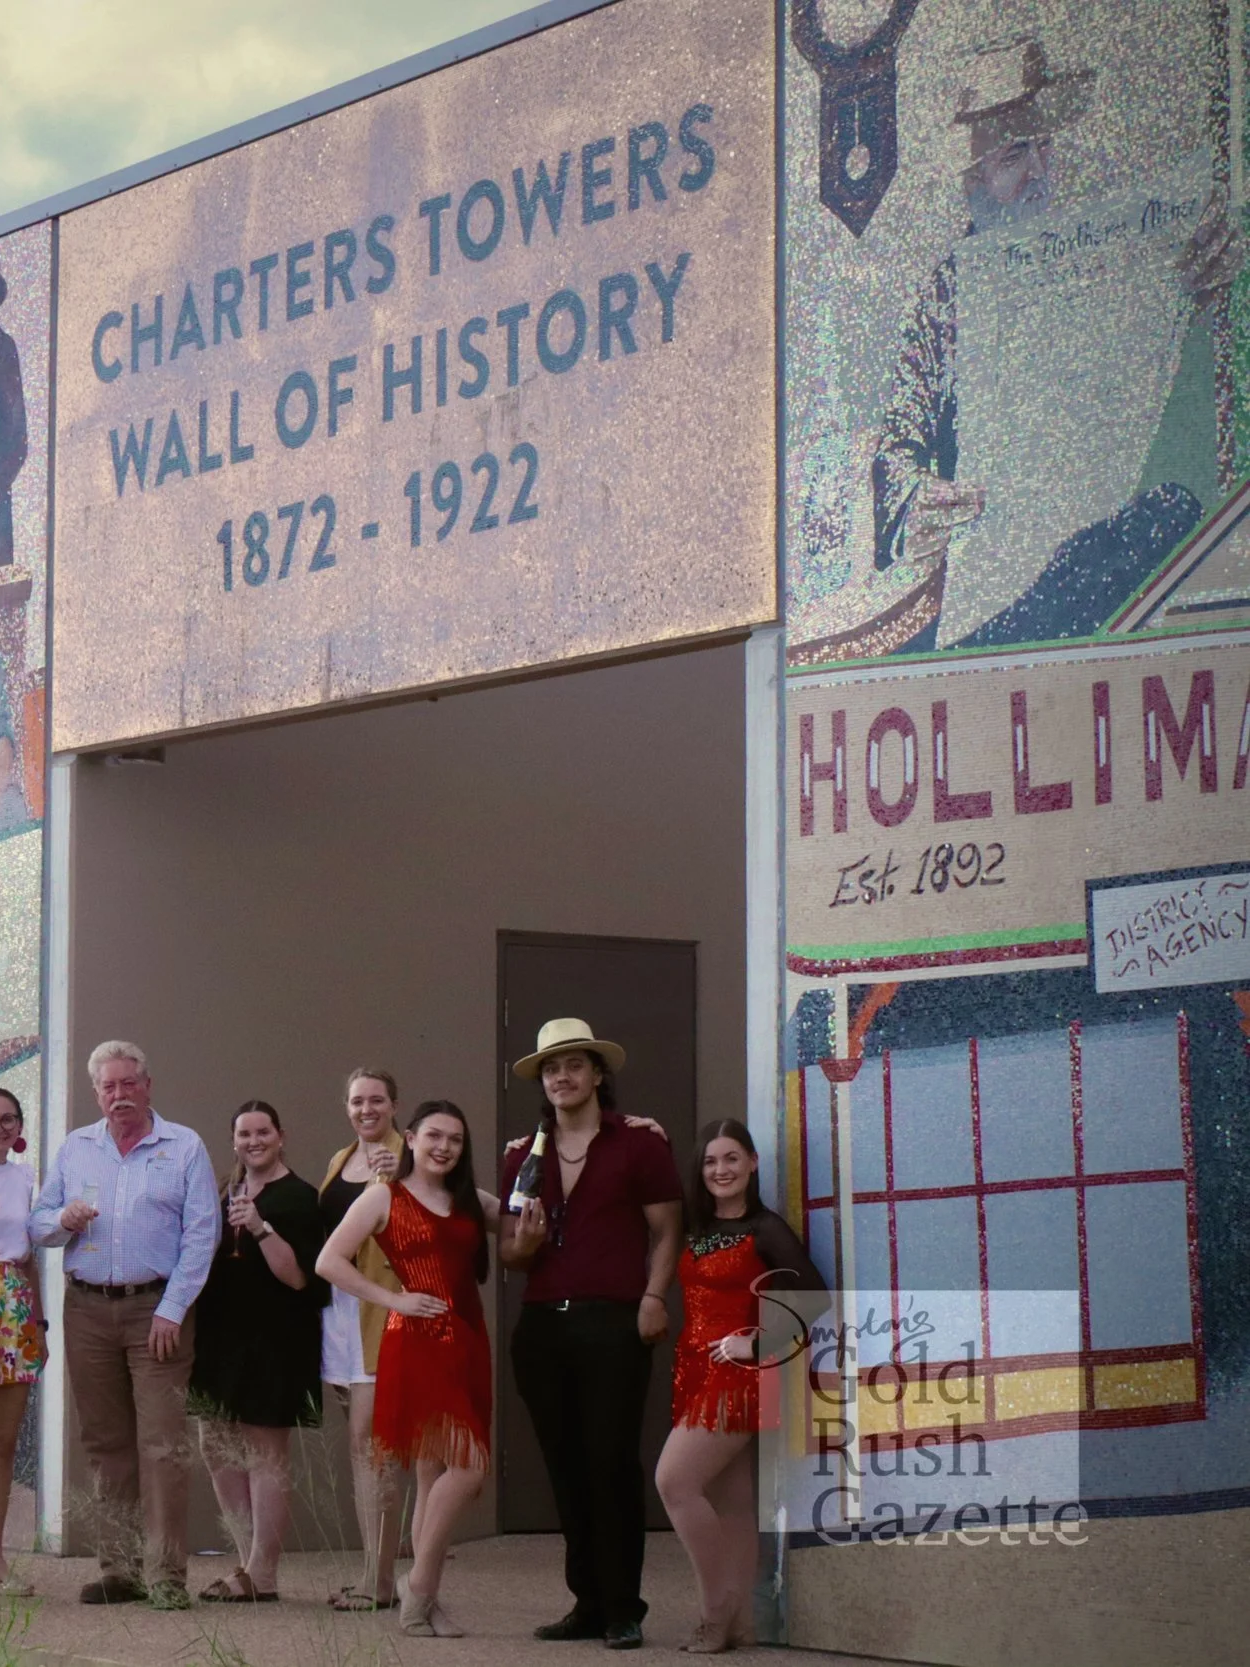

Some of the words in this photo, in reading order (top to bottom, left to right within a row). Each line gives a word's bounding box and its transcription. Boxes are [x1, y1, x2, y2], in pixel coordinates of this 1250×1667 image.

[91, 213, 396, 384] CHARTERS
[418, 102, 716, 276] TOWERS
[109, 390, 255, 499] WALL
[275, 354, 358, 449] OF
[382, 252, 692, 424] HISTORY
[216, 493, 338, 592] 1872
[403, 441, 540, 548] 1922
[799, 669, 1250, 837] HOLLIM
[828, 849, 900, 909] Est.
[910, 842, 1006, 896] 1892
[1105, 881, 1207, 960] DISTRICT
[1147, 898, 1248, 977] AGENCY
